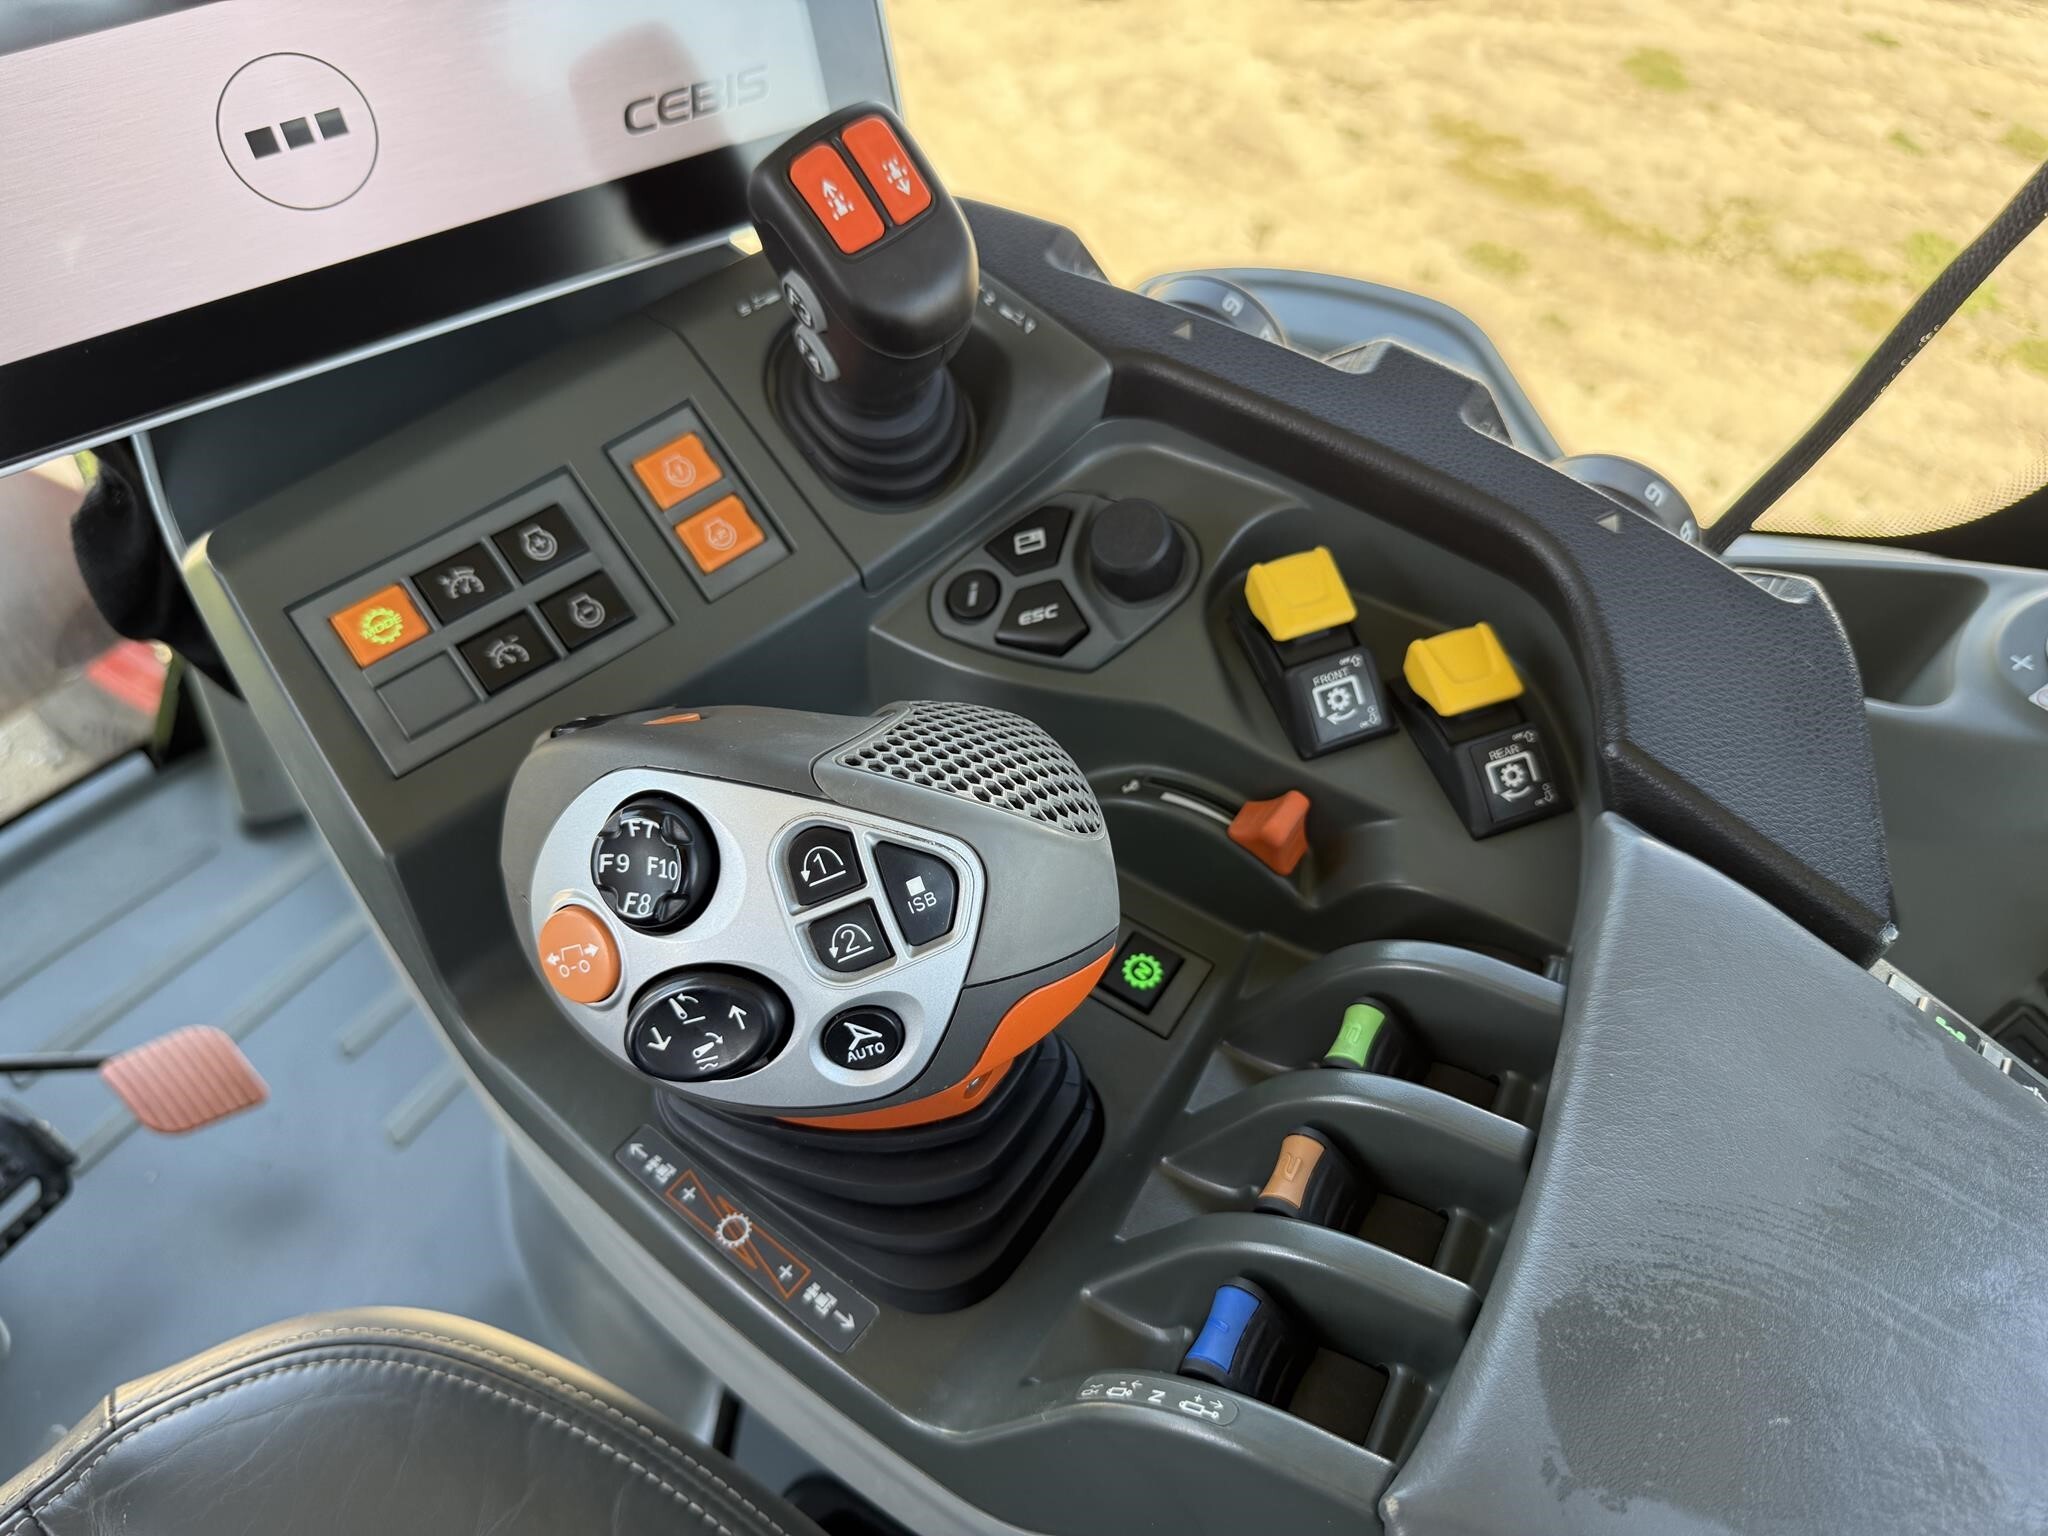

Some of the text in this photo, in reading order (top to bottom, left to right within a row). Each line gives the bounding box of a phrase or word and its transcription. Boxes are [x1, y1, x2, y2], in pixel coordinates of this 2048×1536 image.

[624, 65, 770, 136] CEBIS
[1018, 603, 1060, 626] ESC
[1312, 666, 1349, 687] FRONT
[1488, 743, 1520, 761] REAR
[627, 818, 656, 839] F7
[599, 853, 630, 873] F9
[647, 856, 678, 880] F10
[813, 852, 827, 875] 1
[623, 892, 651, 915] F8
[907, 891, 937, 914] ISB
[840, 929, 861, 953] 2
[847, 1041, 886, 1063] AUTO
[1147, 1389, 1166, 1404] N
